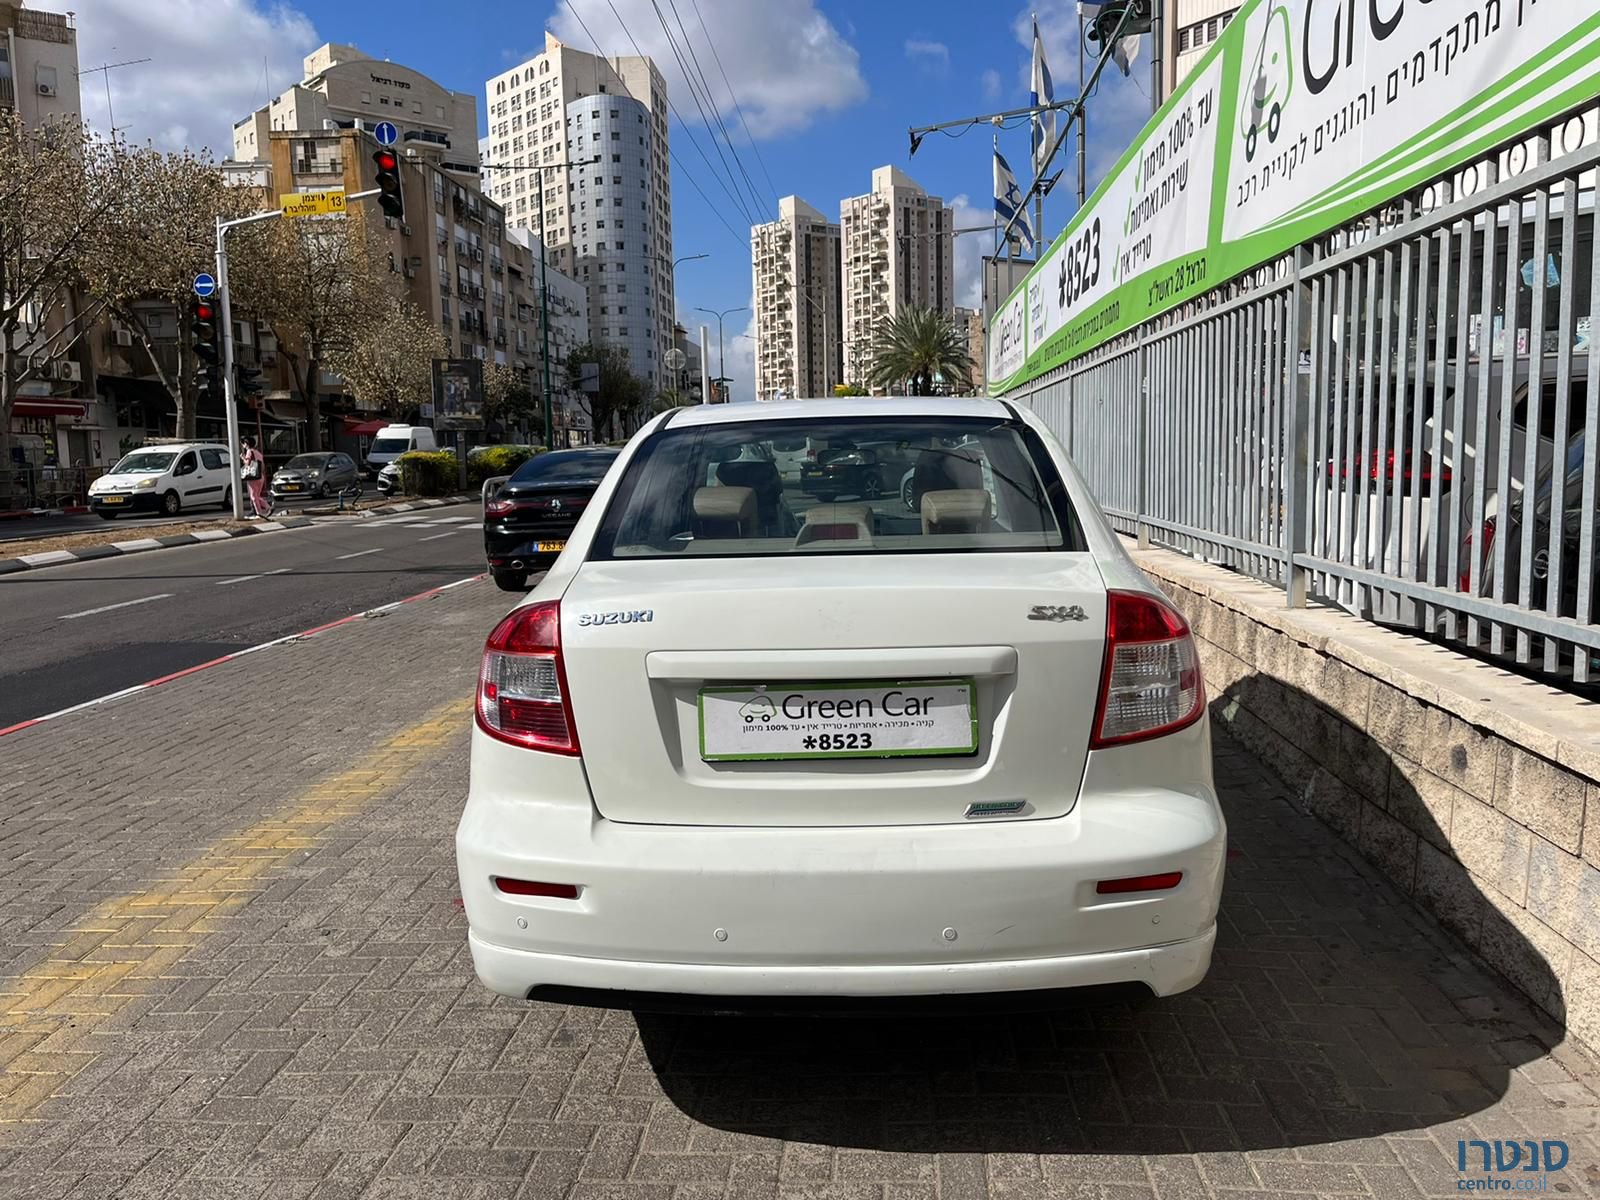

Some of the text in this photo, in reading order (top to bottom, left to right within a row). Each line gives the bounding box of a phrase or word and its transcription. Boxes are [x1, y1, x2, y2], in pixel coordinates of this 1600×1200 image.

[1387, 0, 1501, 105] מתקדמים
[1313, 85, 1376, 155] והוגנים
[1143, 88, 1213, 193] עד 100% מימון
[1260, 132, 1308, 191] לקניית
[301, 194, 321, 204] ויצמן
[1129, 158, 1189, 235] שירות ואמינות
[1237, 173, 1258, 207] רכב
[289, 202, 317, 213] מוהליבר
[331, 195, 342, 207] 13
[1120, 232, 1152, 285] טרייד אין
[1174, 264, 1185, 293] 28
[1185, 257, 1207, 287] הרצל
[578, 609, 654, 627] SUZUKI
[1027, 605, 1090, 623] SX4
[782, 691, 934, 720] Green Car
[743, 724, 764, 733] מימון
[766, 724, 789, 732] 100%
[807, 723, 819, 732] אין
[821, 722, 843, 730] טרייד
[849, 721, 878, 729] אחריות
[884, 720, 910, 728] מכירה
[916, 719, 934, 728] קניה
